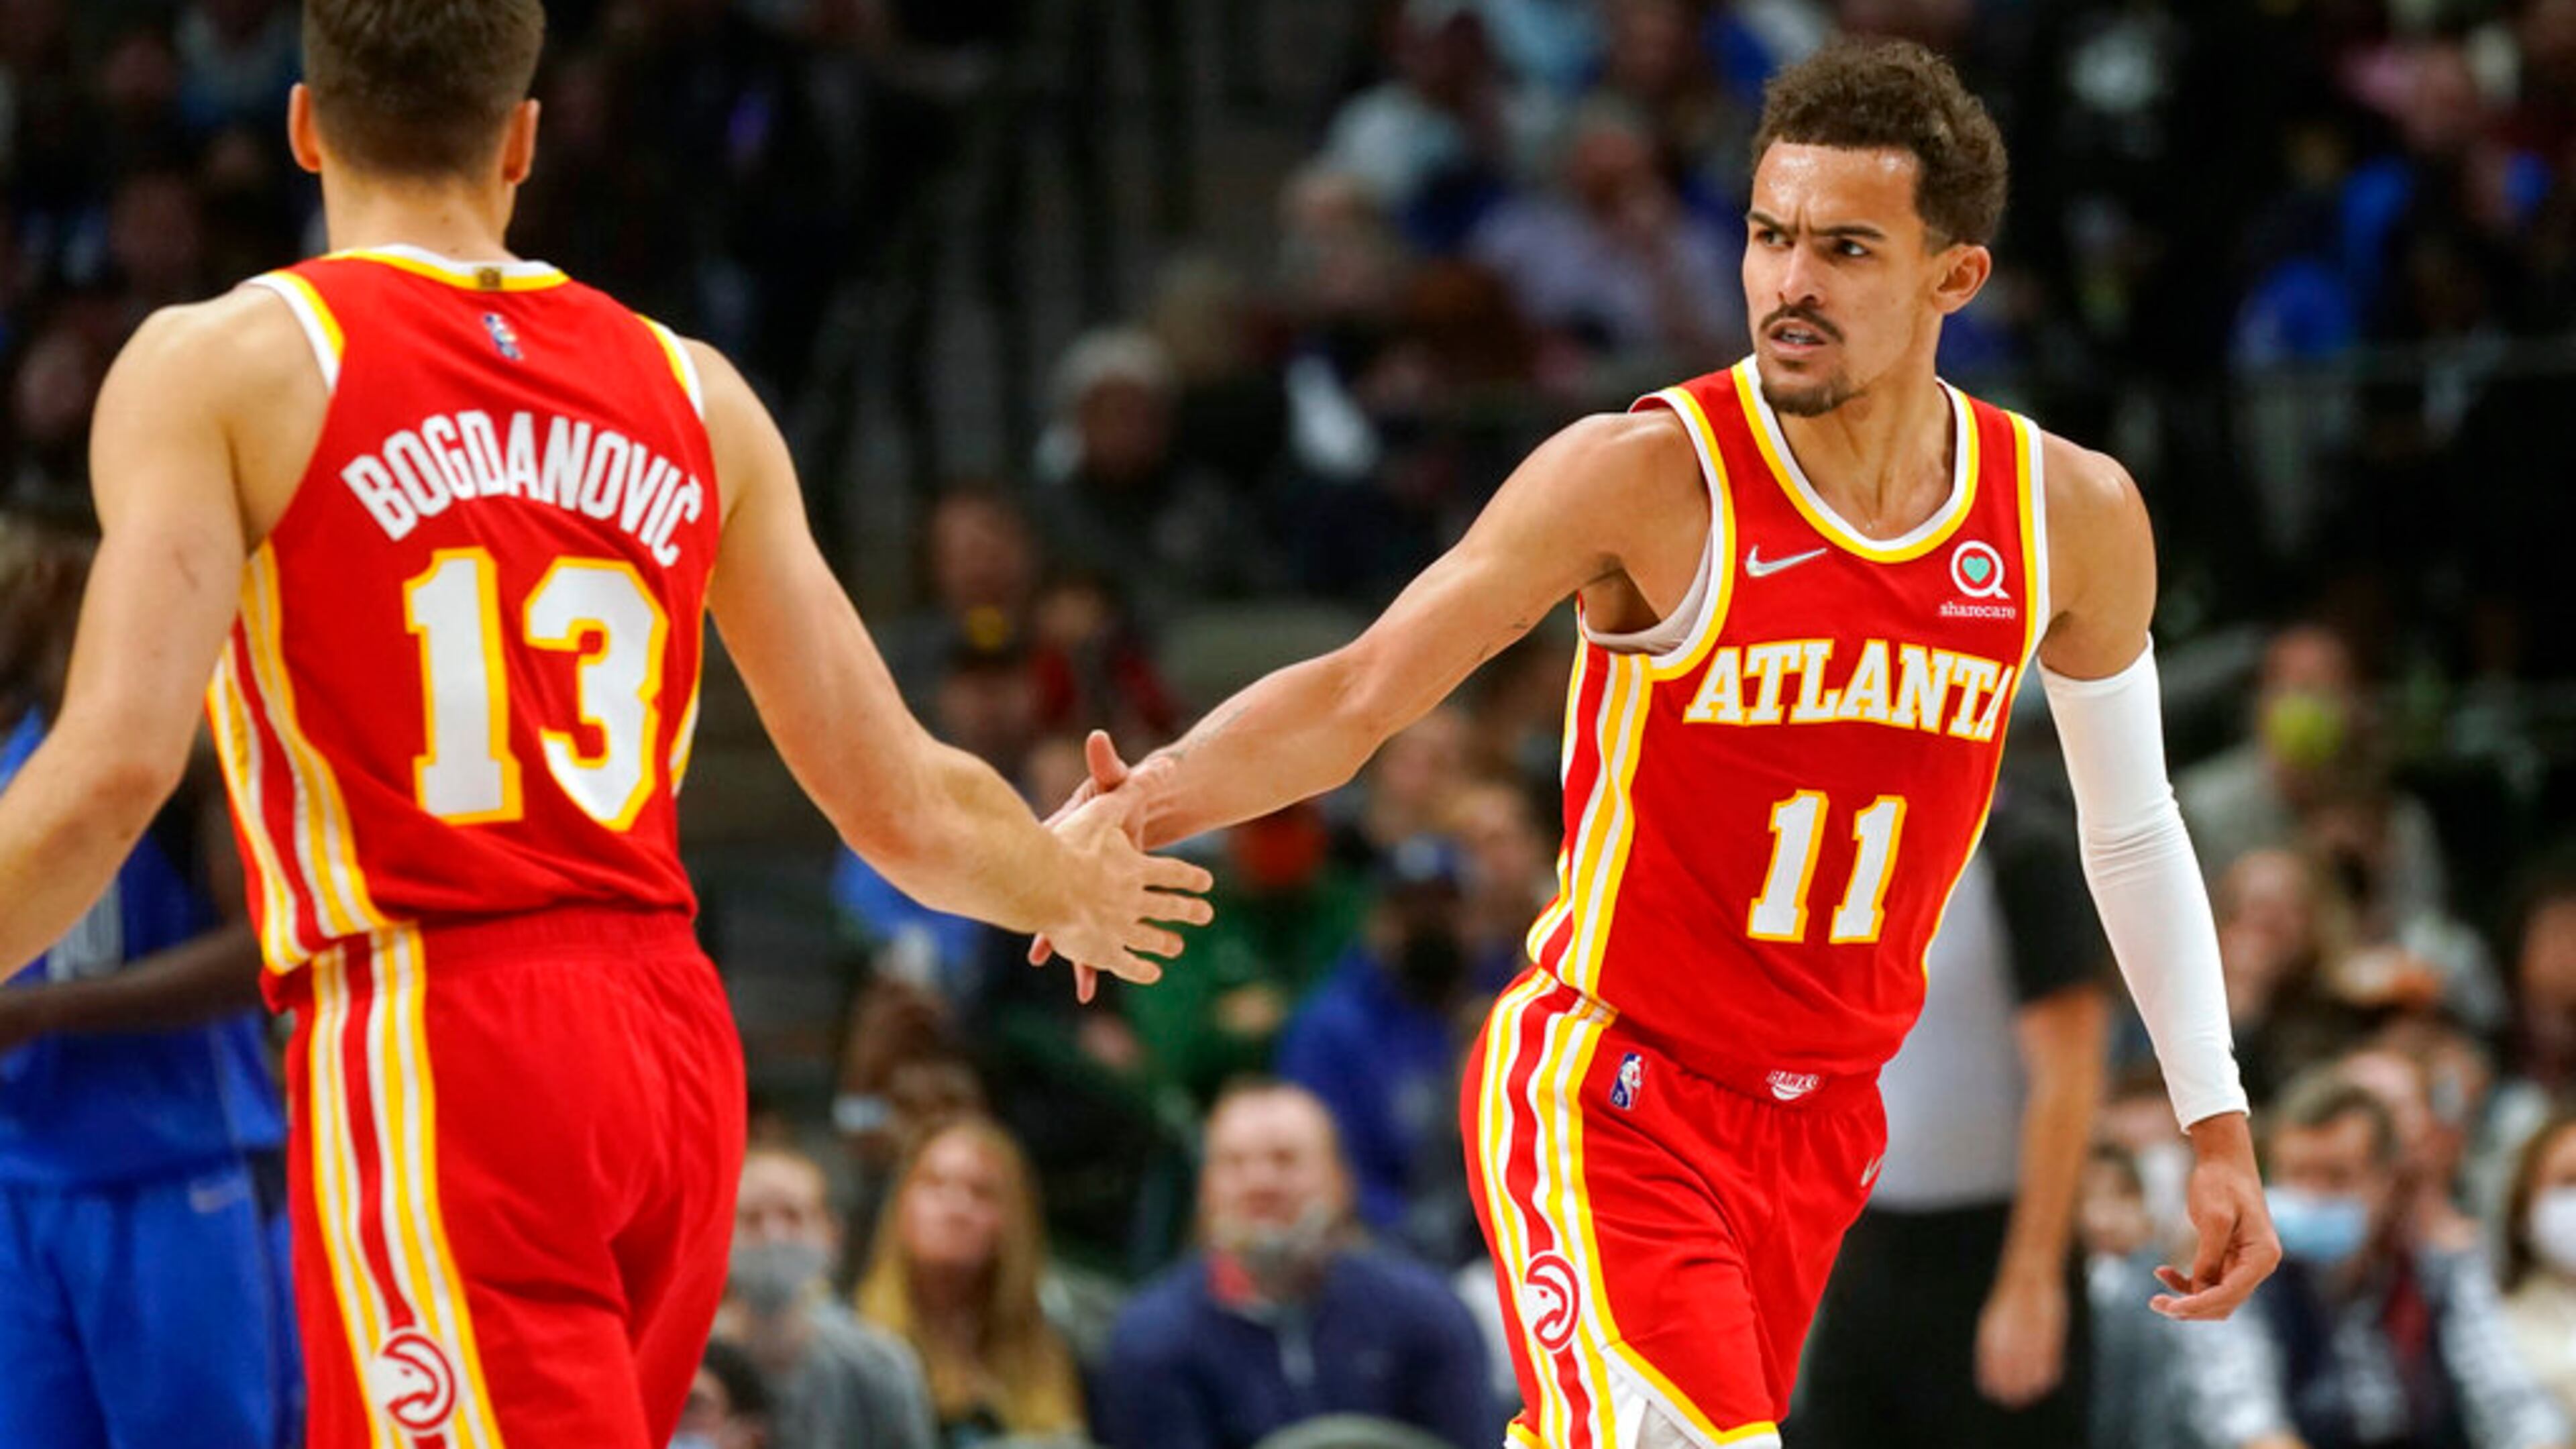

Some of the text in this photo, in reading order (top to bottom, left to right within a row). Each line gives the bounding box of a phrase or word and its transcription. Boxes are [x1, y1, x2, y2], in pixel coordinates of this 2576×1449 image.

[341, 409, 702, 567] BOGDANOVIĆ
[1940, 601, 2016, 619] sharecare
[402, 547, 669, 832] 13
[1682, 638, 2015, 743] ATLANTA
[1747, 789, 1907, 945] 11
